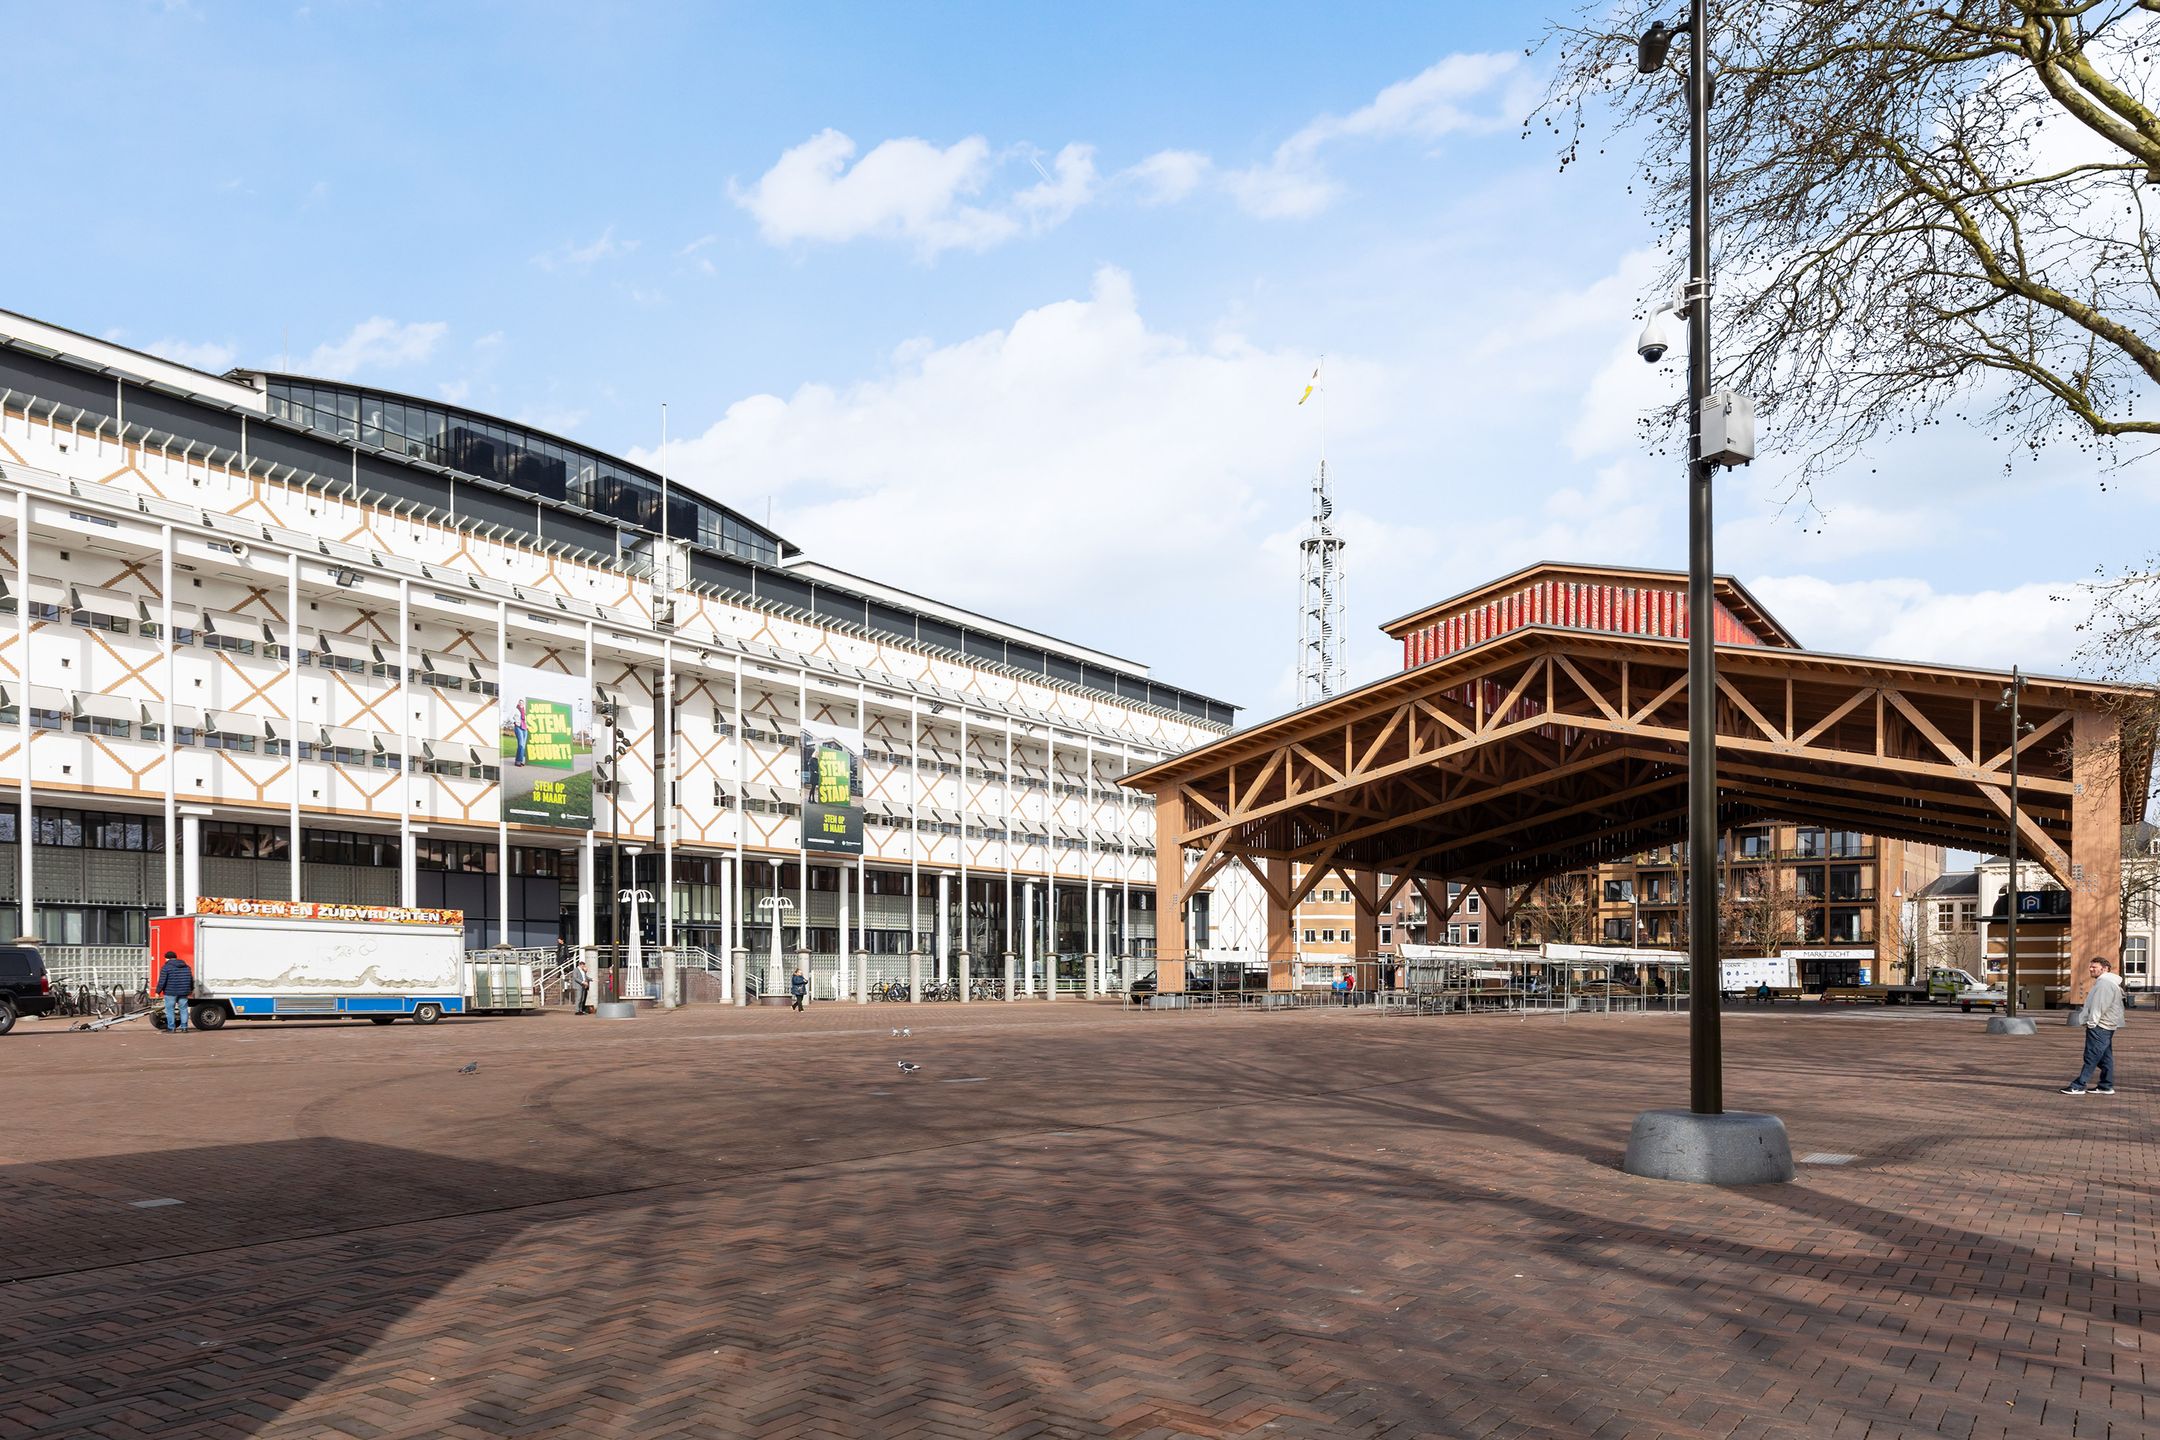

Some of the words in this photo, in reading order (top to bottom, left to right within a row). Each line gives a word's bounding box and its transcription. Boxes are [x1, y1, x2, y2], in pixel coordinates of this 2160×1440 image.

[529, 703, 552, 714] JOUW
[526, 713, 572, 736] STEM,
[529, 733, 552, 744] JOUW
[526, 743, 573, 761] BUURT!
[819, 760, 850, 778] STEM,
[534, 780, 554, 792] STEM
[555, 782, 566, 794] OP
[819, 785, 850, 803] STAD!
[532, 790, 541, 802] 18
[542, 792, 567, 805] MAART
[824, 814, 838, 824] STEM
[838, 815, 846, 825] OP
[224, 902, 285, 915] NOTEN
[290, 905, 313, 917] EN
[318, 907, 440, 921] ZUIDVRUCHTEN
